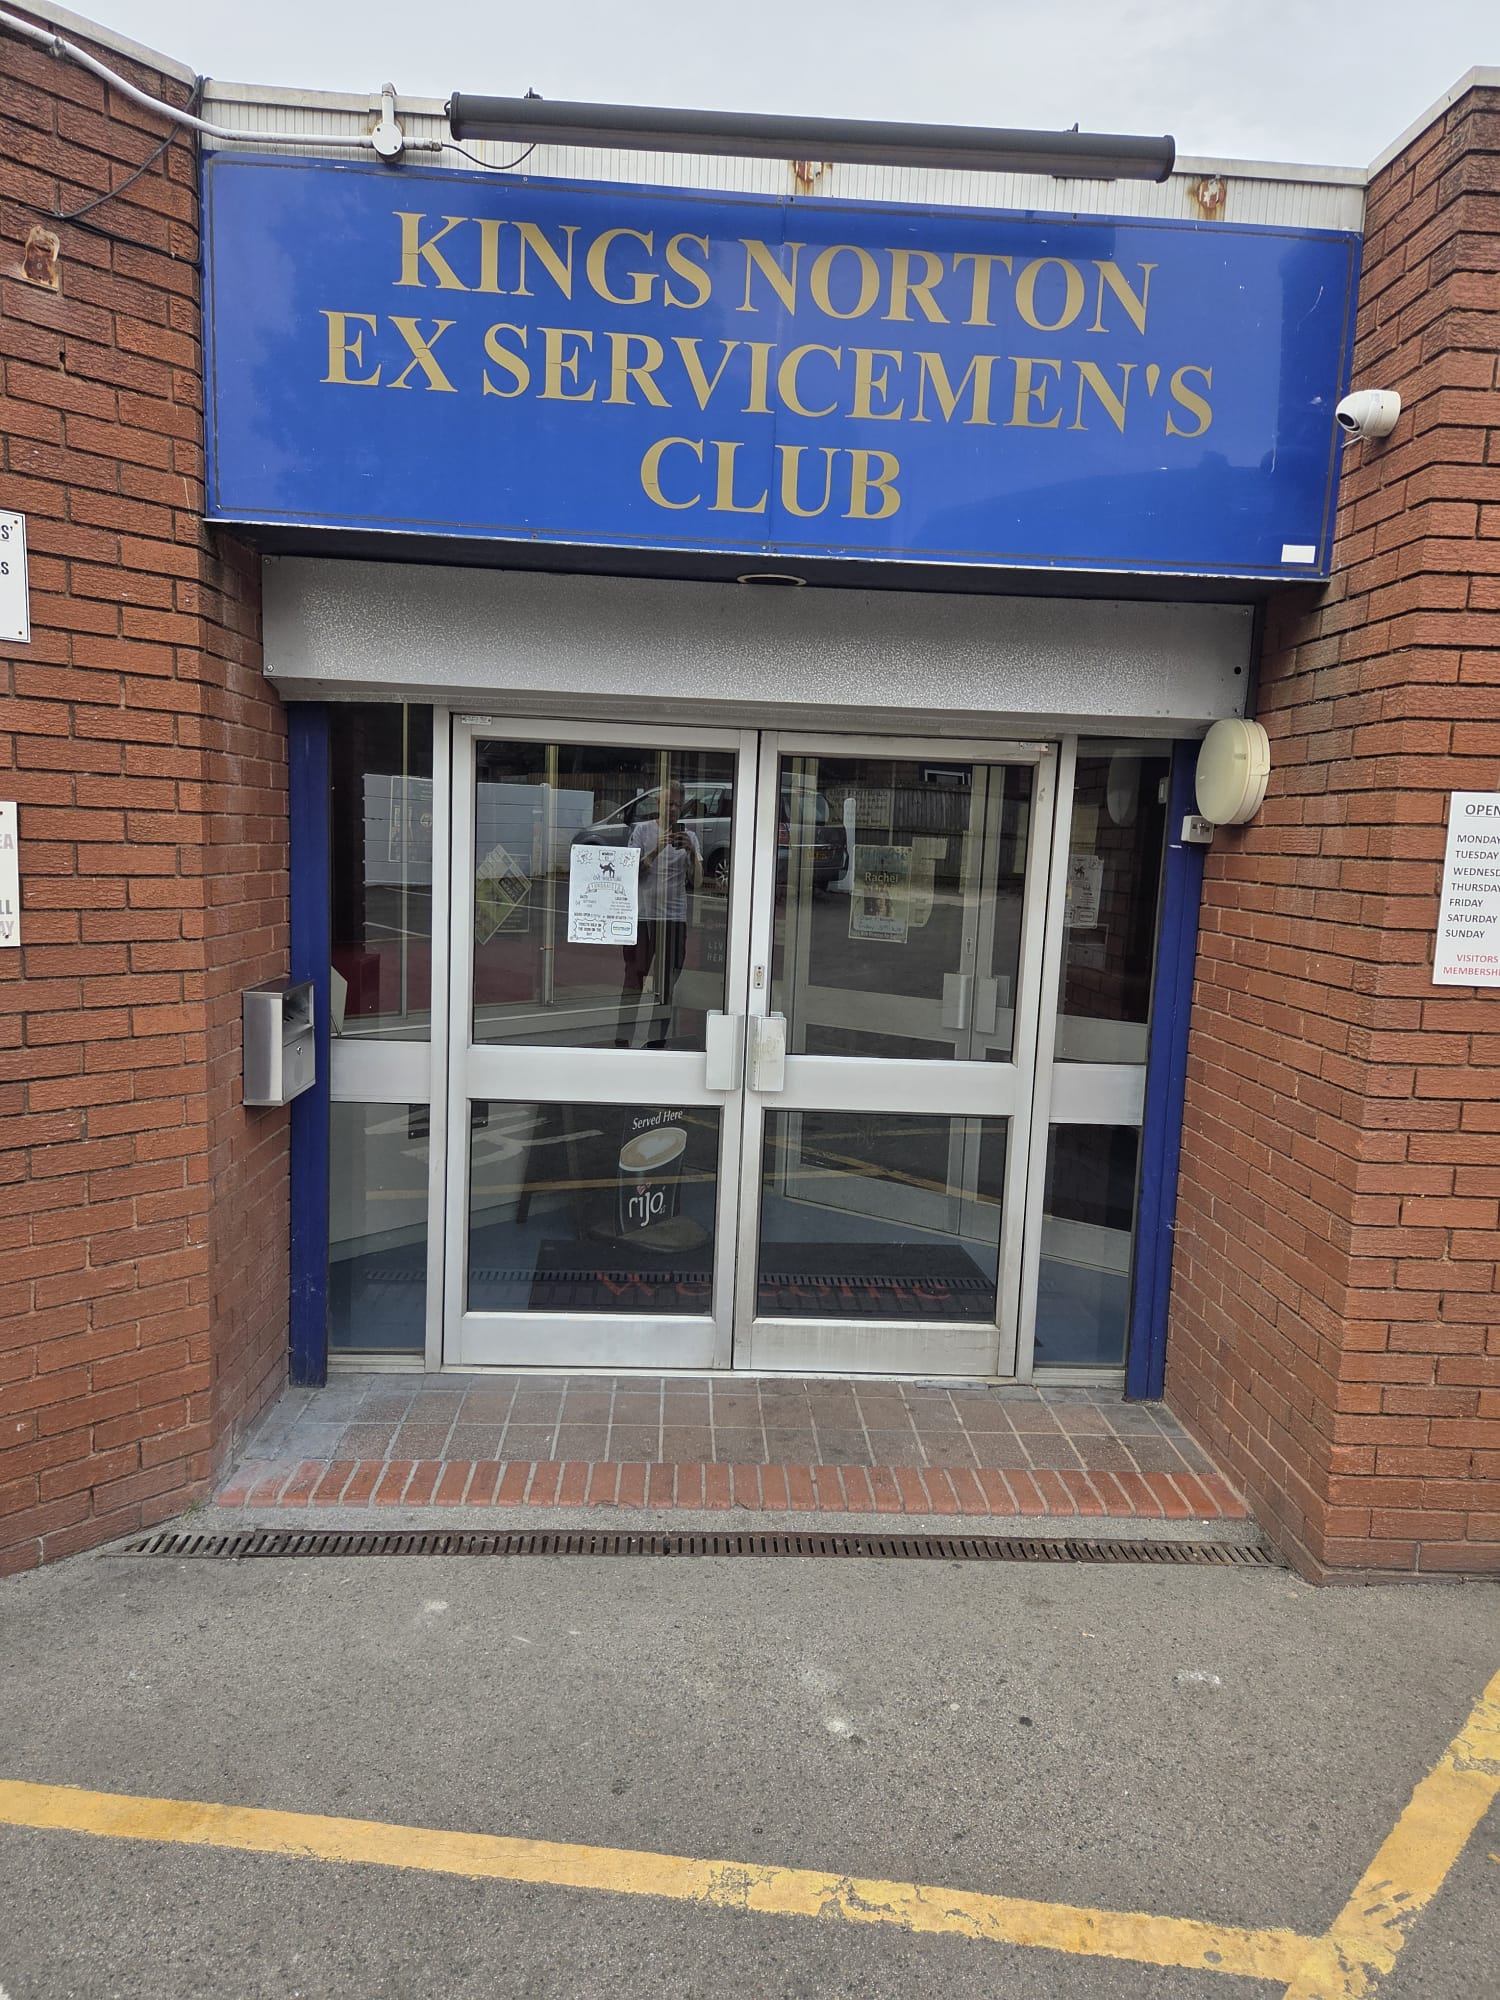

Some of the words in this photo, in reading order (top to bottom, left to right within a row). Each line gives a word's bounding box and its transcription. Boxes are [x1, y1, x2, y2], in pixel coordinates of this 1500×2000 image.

[395, 211, 713, 309] KINGS
[737, 239, 1156, 335] NORTON
[319, 310, 457, 393] EX
[482, 323, 1213, 438] SERVICEMEN'S
[638, 436, 902, 520] CLUB
[1456, 850, 1499, 860] TUESDAY
[1449, 898, 1484, 908] FRIDAY
[1447, 913, 1498, 924] SATURDAY
[1445, 929, 1486, 939] SUNDAY
[1456, 953, 1499, 964] VISITORS
[632, 1112, 663, 1130] Served
[662, 1110, 684, 1124] Here
